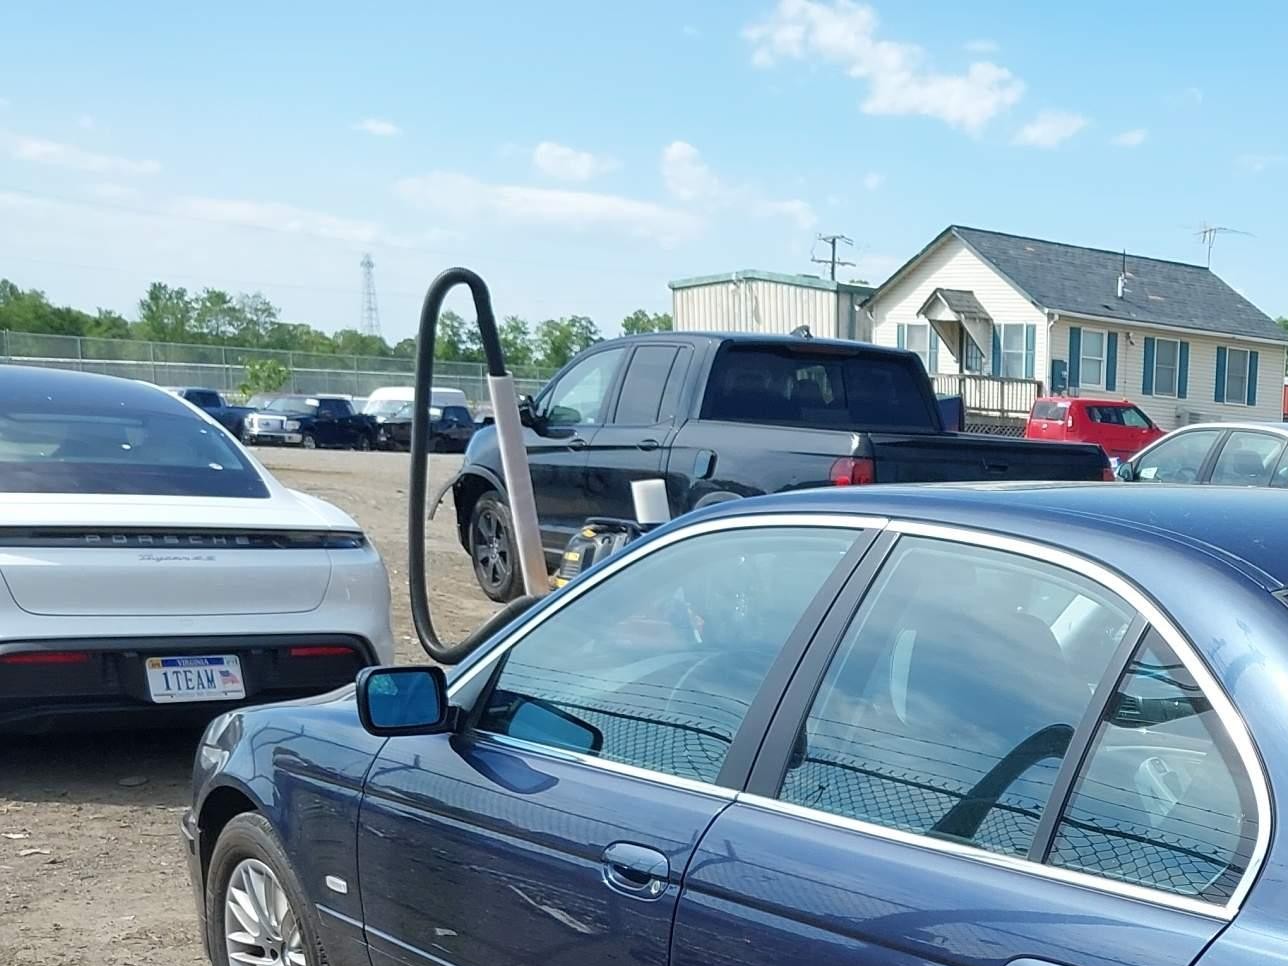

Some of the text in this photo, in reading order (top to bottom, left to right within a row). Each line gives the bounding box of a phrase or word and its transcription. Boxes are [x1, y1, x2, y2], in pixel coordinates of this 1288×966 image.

[85, 534, 250, 545] PORSCHE
[176, 658, 210, 667] VIRGINIA
[162, 669, 217, 691] 1TEAM
